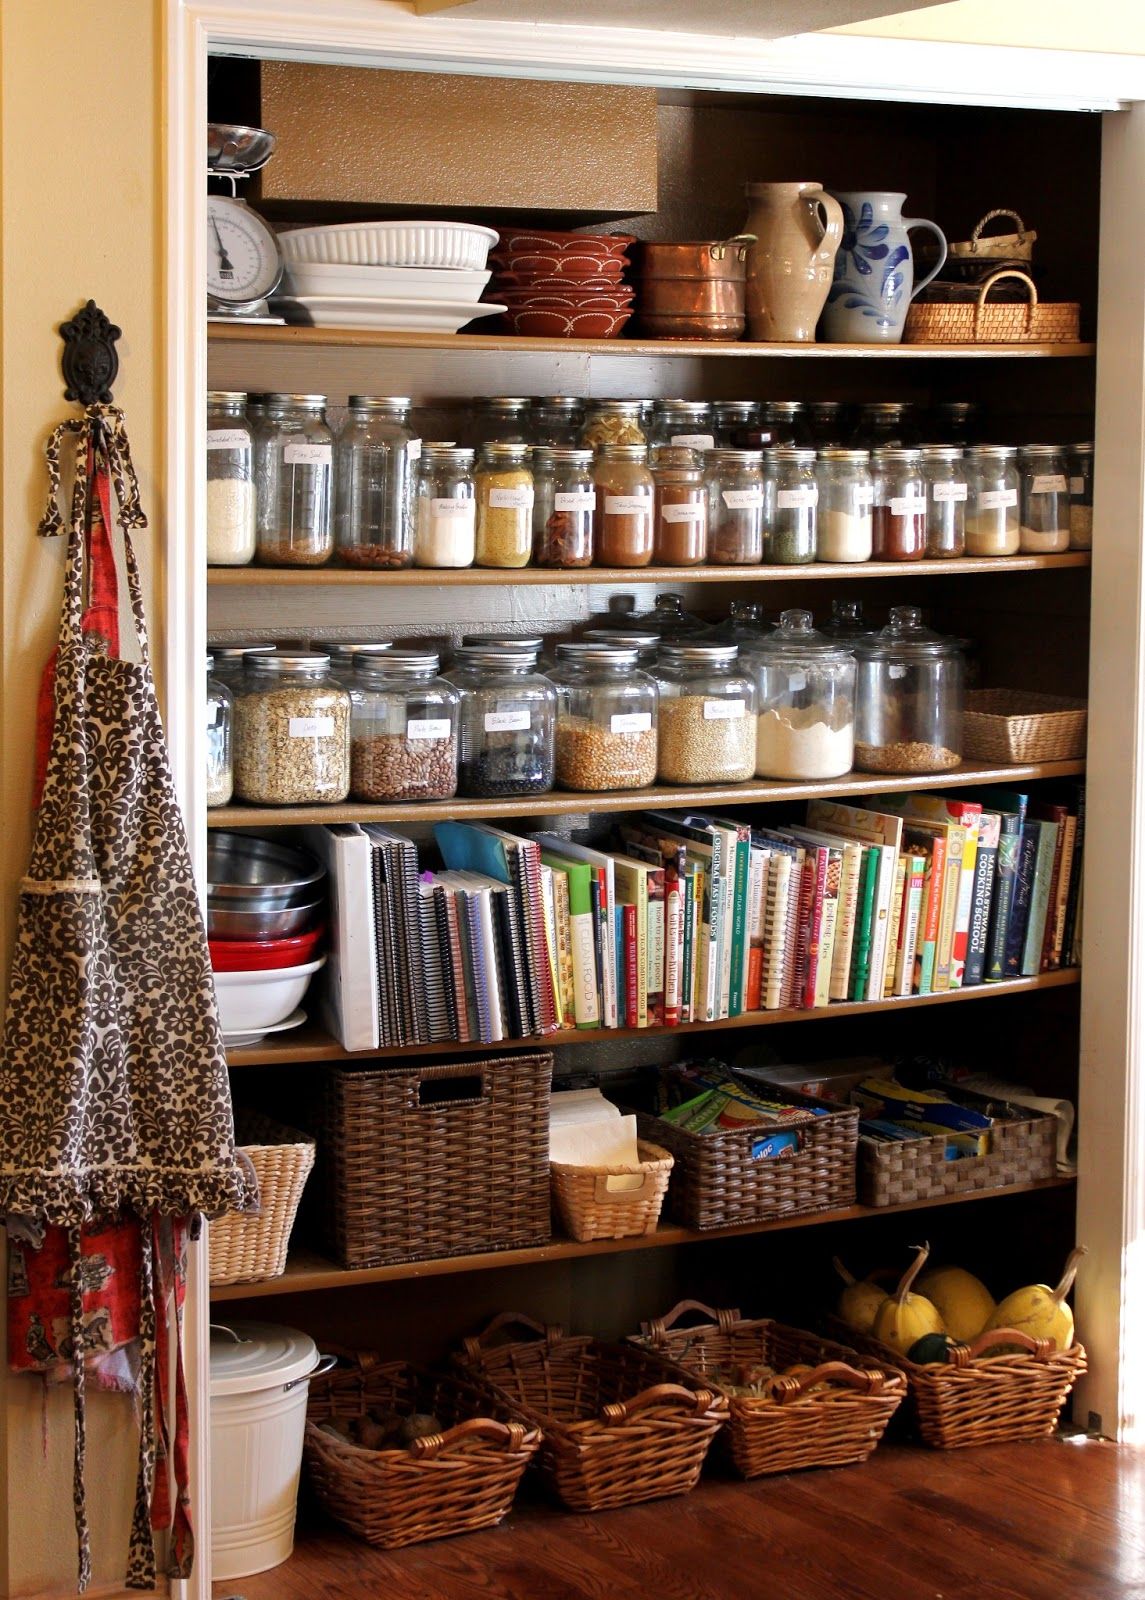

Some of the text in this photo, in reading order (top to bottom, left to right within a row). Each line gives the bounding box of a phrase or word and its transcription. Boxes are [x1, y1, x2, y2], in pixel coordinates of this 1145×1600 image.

[713, 837, 721, 882] ORIGINAL
[753, 879, 761, 908] Minutes
[816, 885, 824, 906] DEEN
[912, 878, 923, 888] LIVE
[970, 853, 987, 953] COOKING SCHOOL
[978, 854, 995, 953] MARTHA STEWART'S
[656, 925, 663, 934] to
[710, 906, 719, 937] FOODS
[582, 929, 592, 965] CLEAN
[655, 936, 663, 953] pick
[584, 968, 594, 1001] FOOD
[629, 976, 636, 984] IN
[655, 962, 663, 988] peach
[752, 1144, 773, 1160] loc
